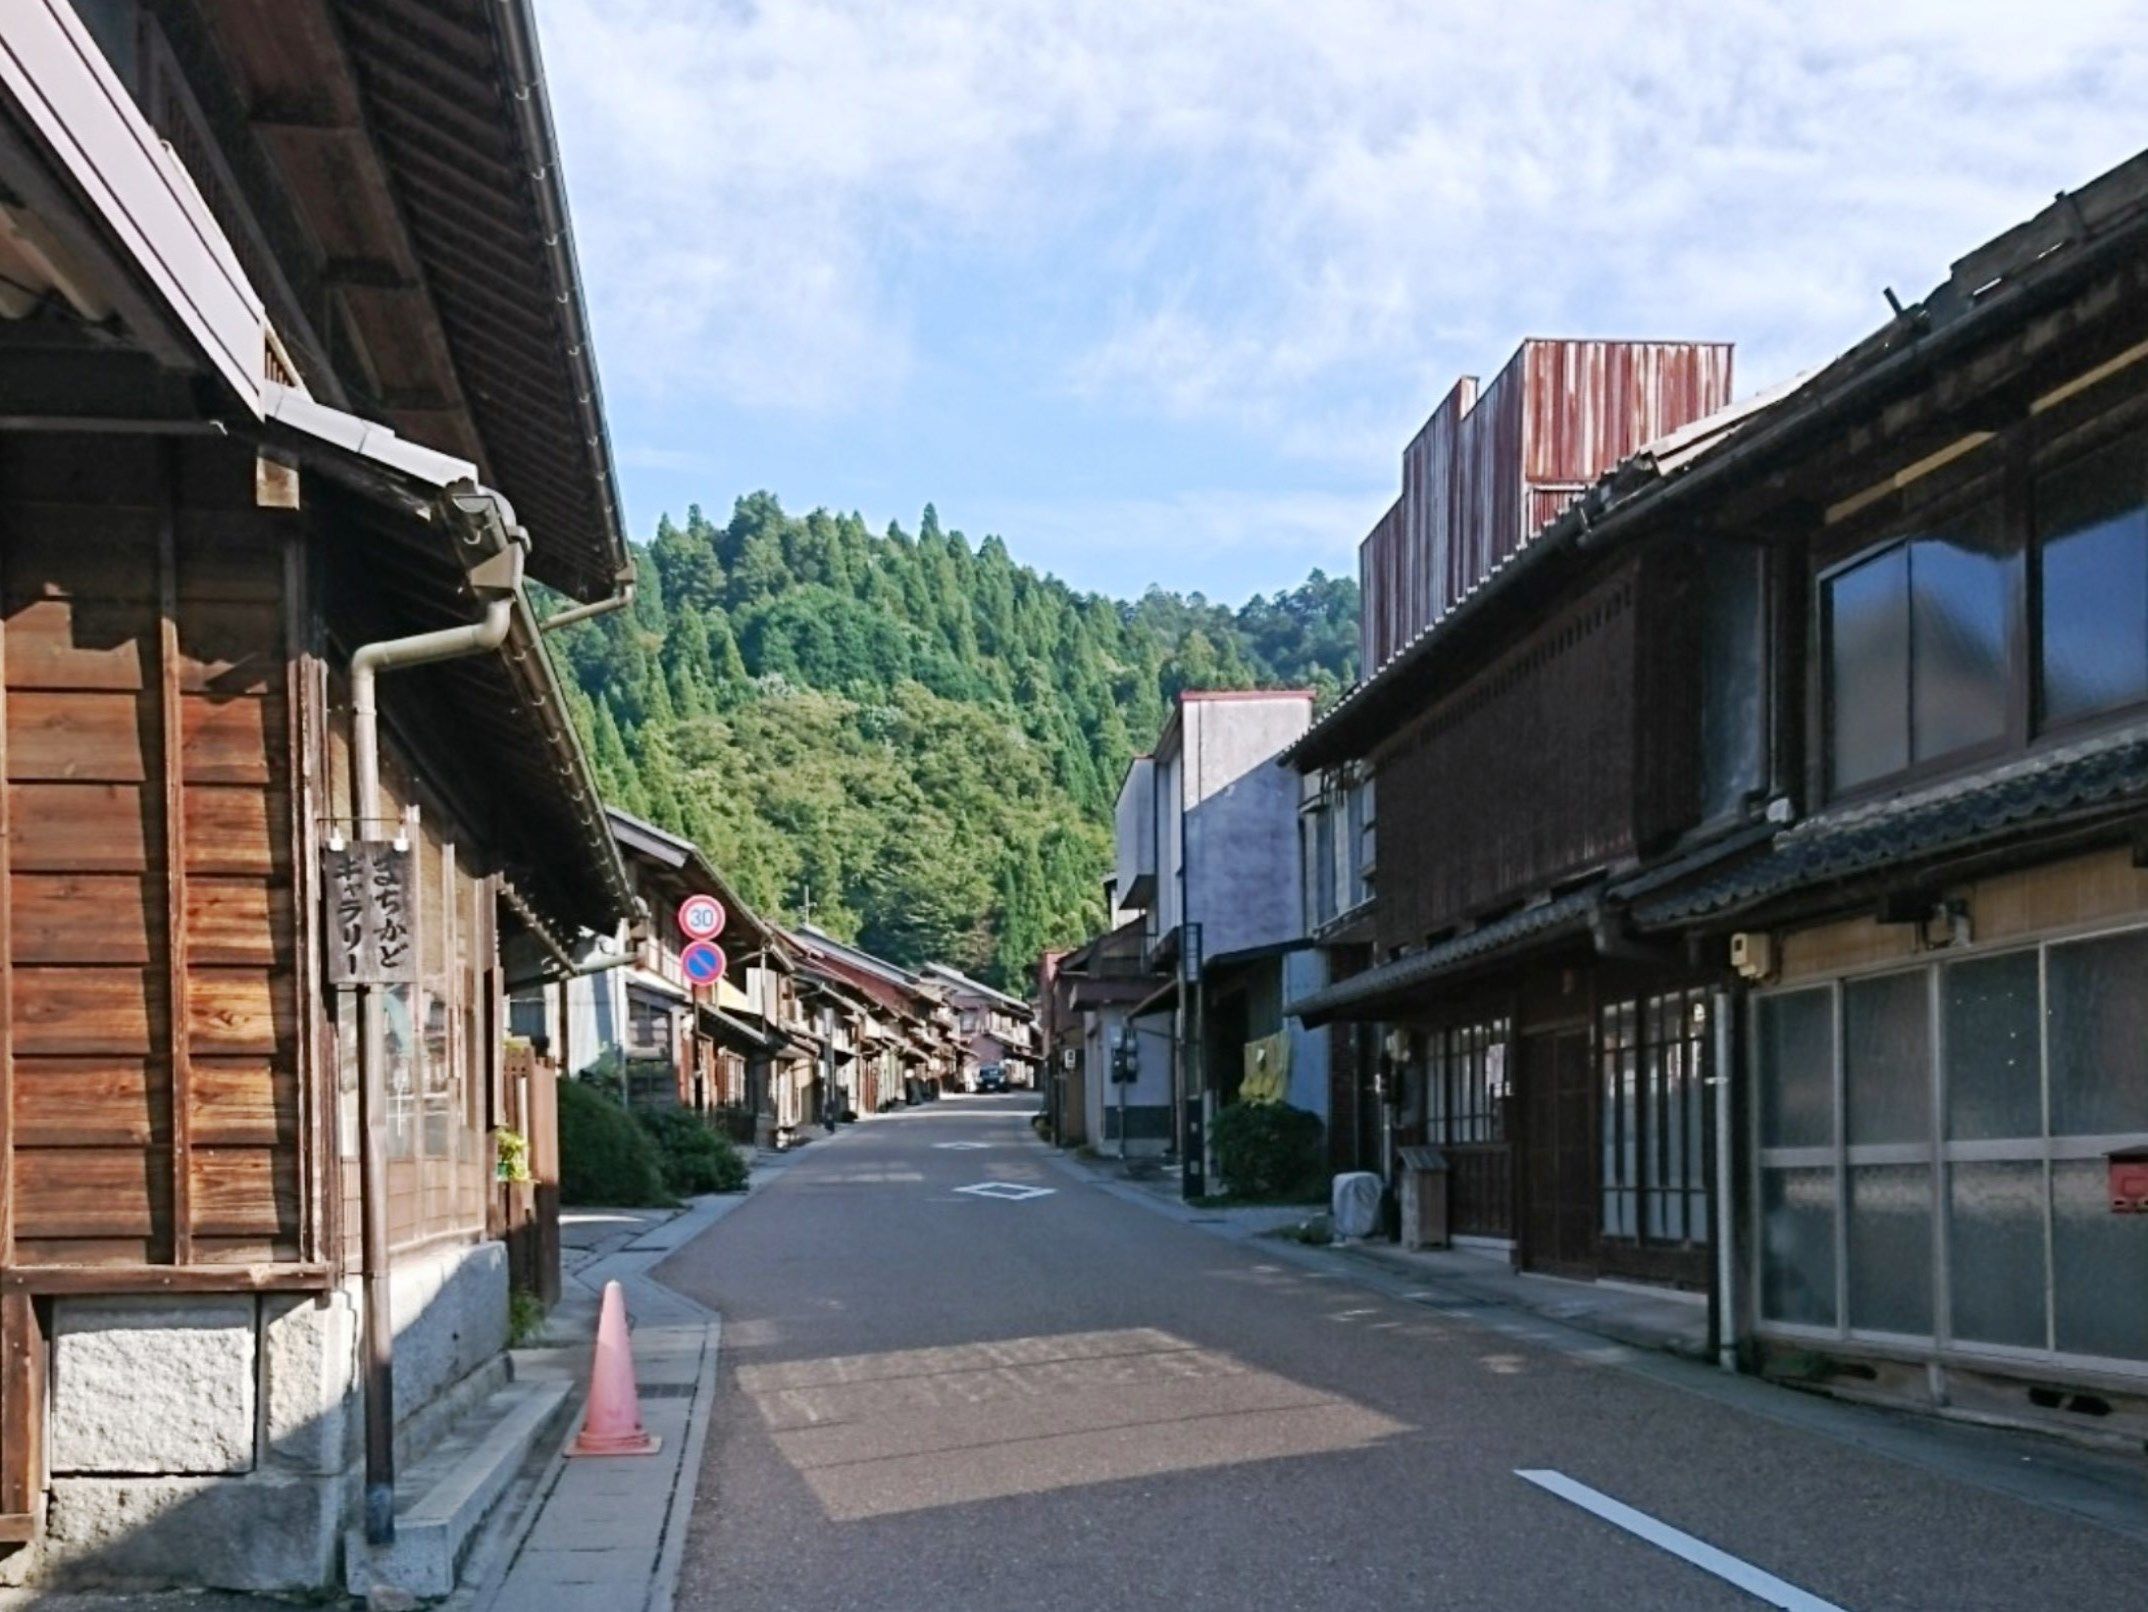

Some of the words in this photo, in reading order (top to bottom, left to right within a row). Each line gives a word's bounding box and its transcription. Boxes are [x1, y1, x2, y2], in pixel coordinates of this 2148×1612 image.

[372, 854, 409, 968] まちかど
[690, 908, 714, 928] 30
